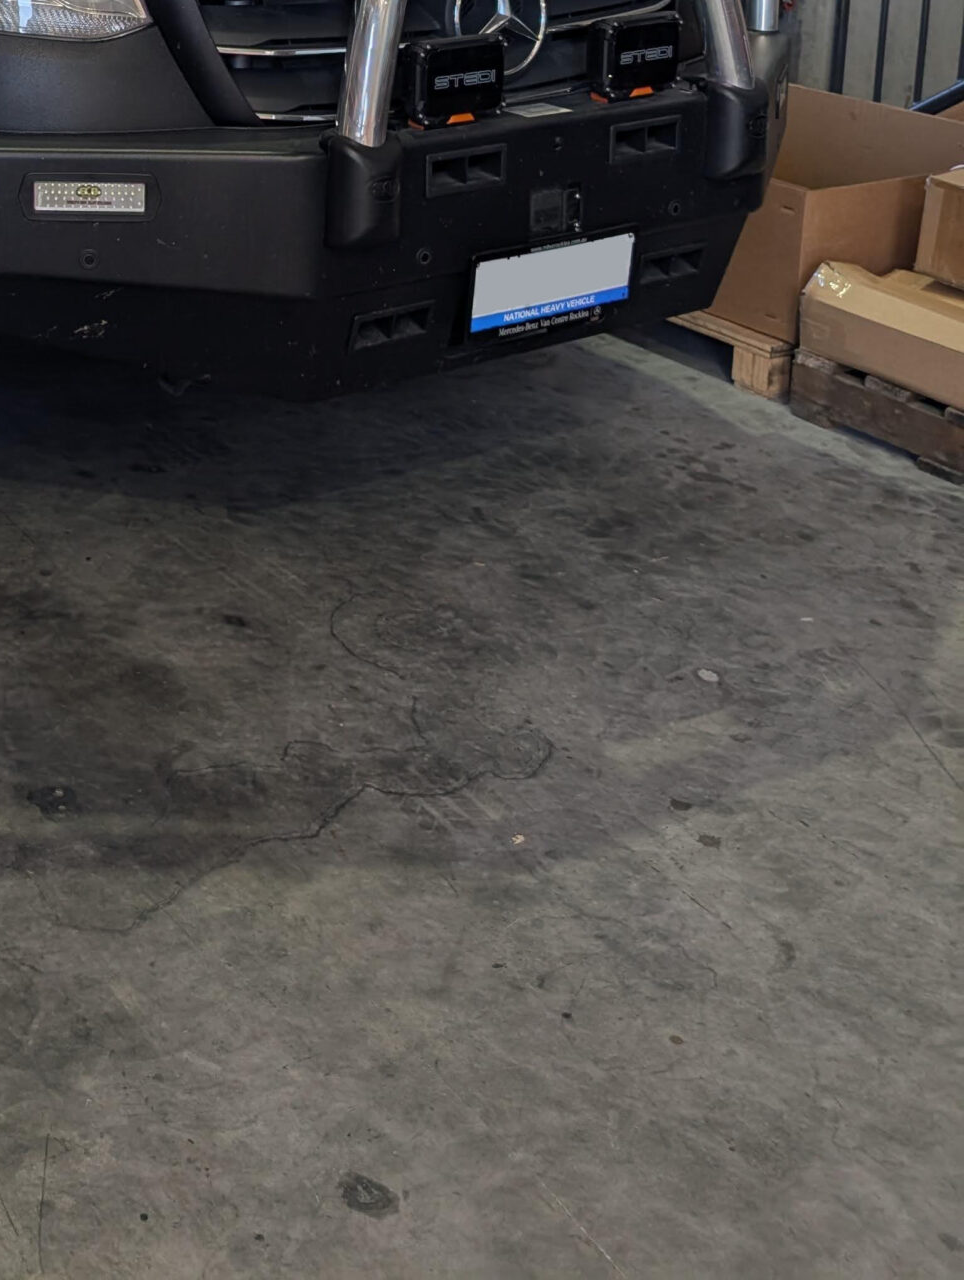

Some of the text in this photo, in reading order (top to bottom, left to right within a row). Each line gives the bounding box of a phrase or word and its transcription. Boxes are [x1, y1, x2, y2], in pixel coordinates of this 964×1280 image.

[620, 45, 673, 65] STEDI
[434, 69, 496, 90] STEDI
[503, 295, 595, 322] NATIONAL HEAVY VEHICLE
[498, 321, 539, 337] Mercedes-Benz
